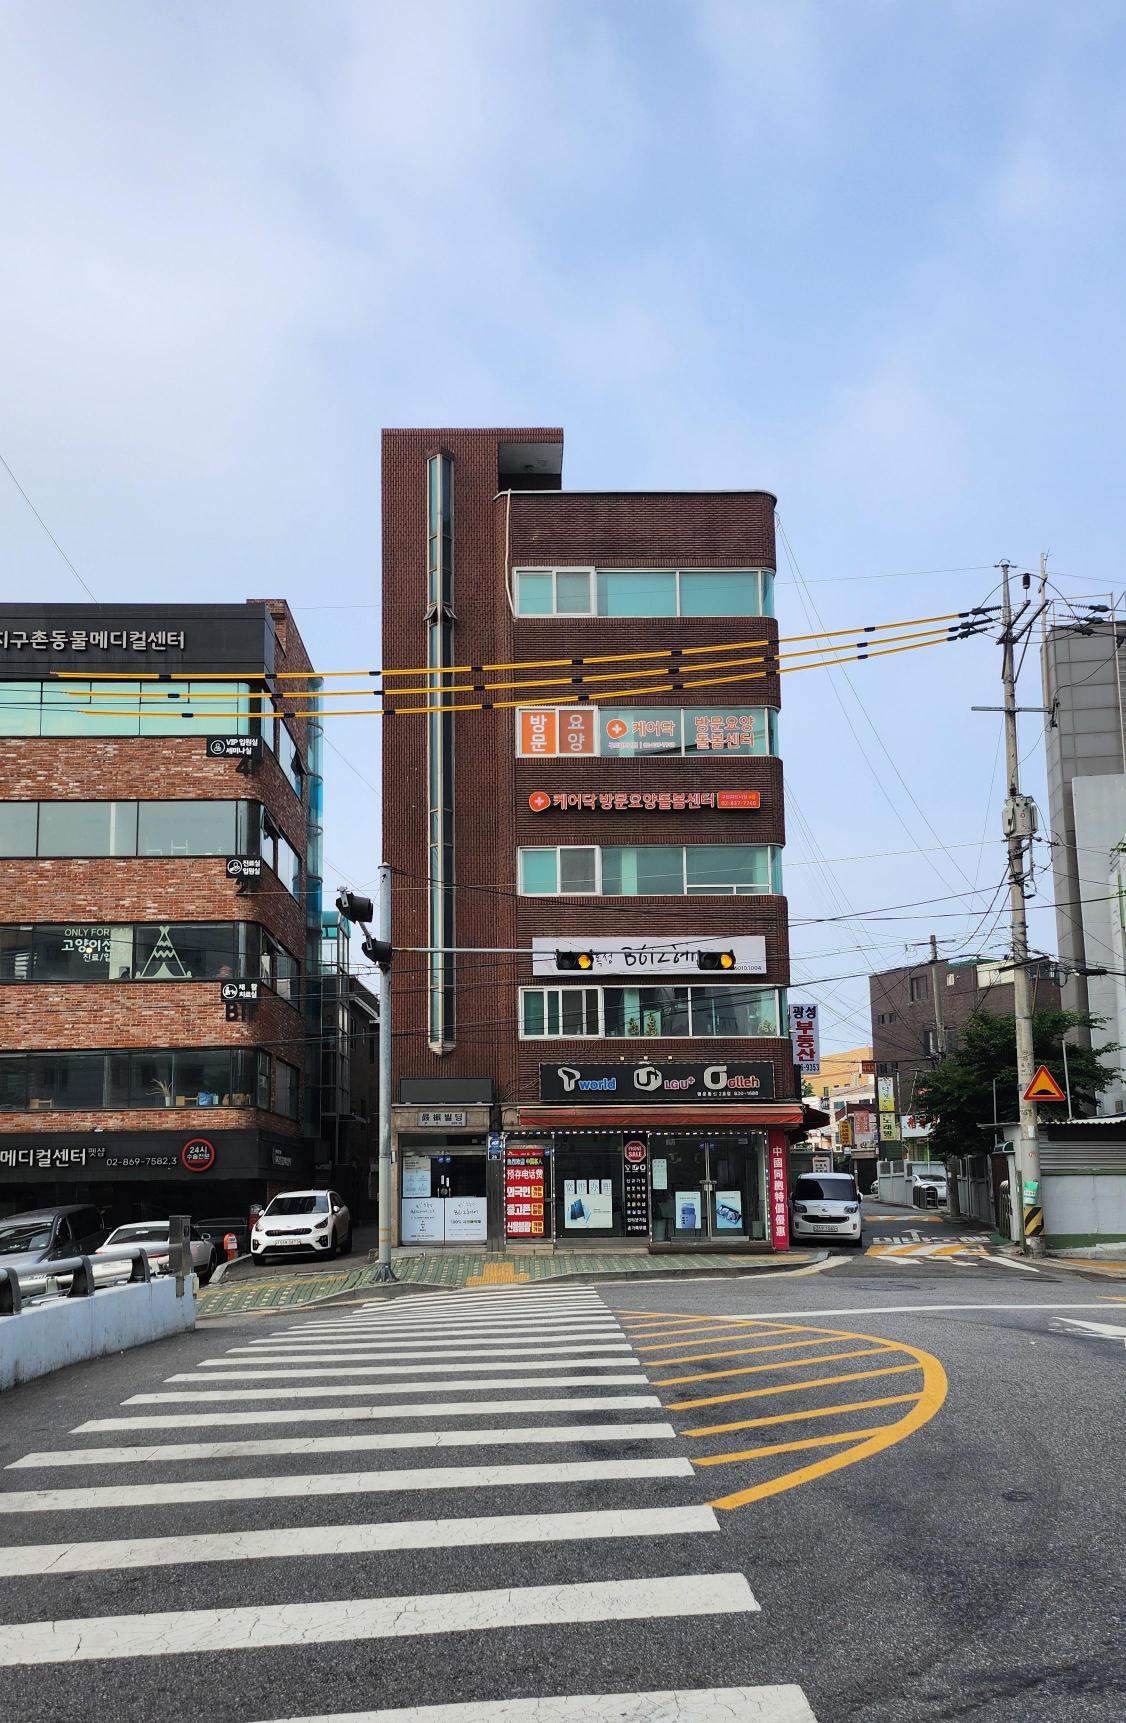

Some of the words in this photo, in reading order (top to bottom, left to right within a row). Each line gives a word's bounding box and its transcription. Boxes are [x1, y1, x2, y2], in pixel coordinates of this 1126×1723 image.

[0, 630, 185, 650] 지구촌동물메디컬센터
[632, 720, 676, 737] 케어닥
[695, 715, 754, 732] 방문요양
[529, 714, 548, 752] 방문
[567, 714, 585, 751] 요양
[226, 738, 238, 746] VIP
[696, 732, 755, 750] 돌봄센터
[226, 747, 252, 755] 세미나실
[553, 793, 598, 810] 케어닥
[599, 792, 715, 811] 방문요양돌봄센터
[64, 928, 89, 937] ONLY
[91, 928, 110, 937] FOR
[792, 1005, 817, 1019] 광성
[795, 1020, 816, 1062] 부동산
[578, 1078, 617, 1091] world
[727, 1075, 760, 1090] olleh
[0, 1148, 86, 1167] 메디컬센터
[88, 1147, 105, 1157] 펫샵
[106, 1157, 177, 1167] 02-869-7582,3
[190, 1146, 207, 1154] 24시
[506, 1186, 531, 1198] 외국인
[506, 1203, 531, 1216] 중고폰
